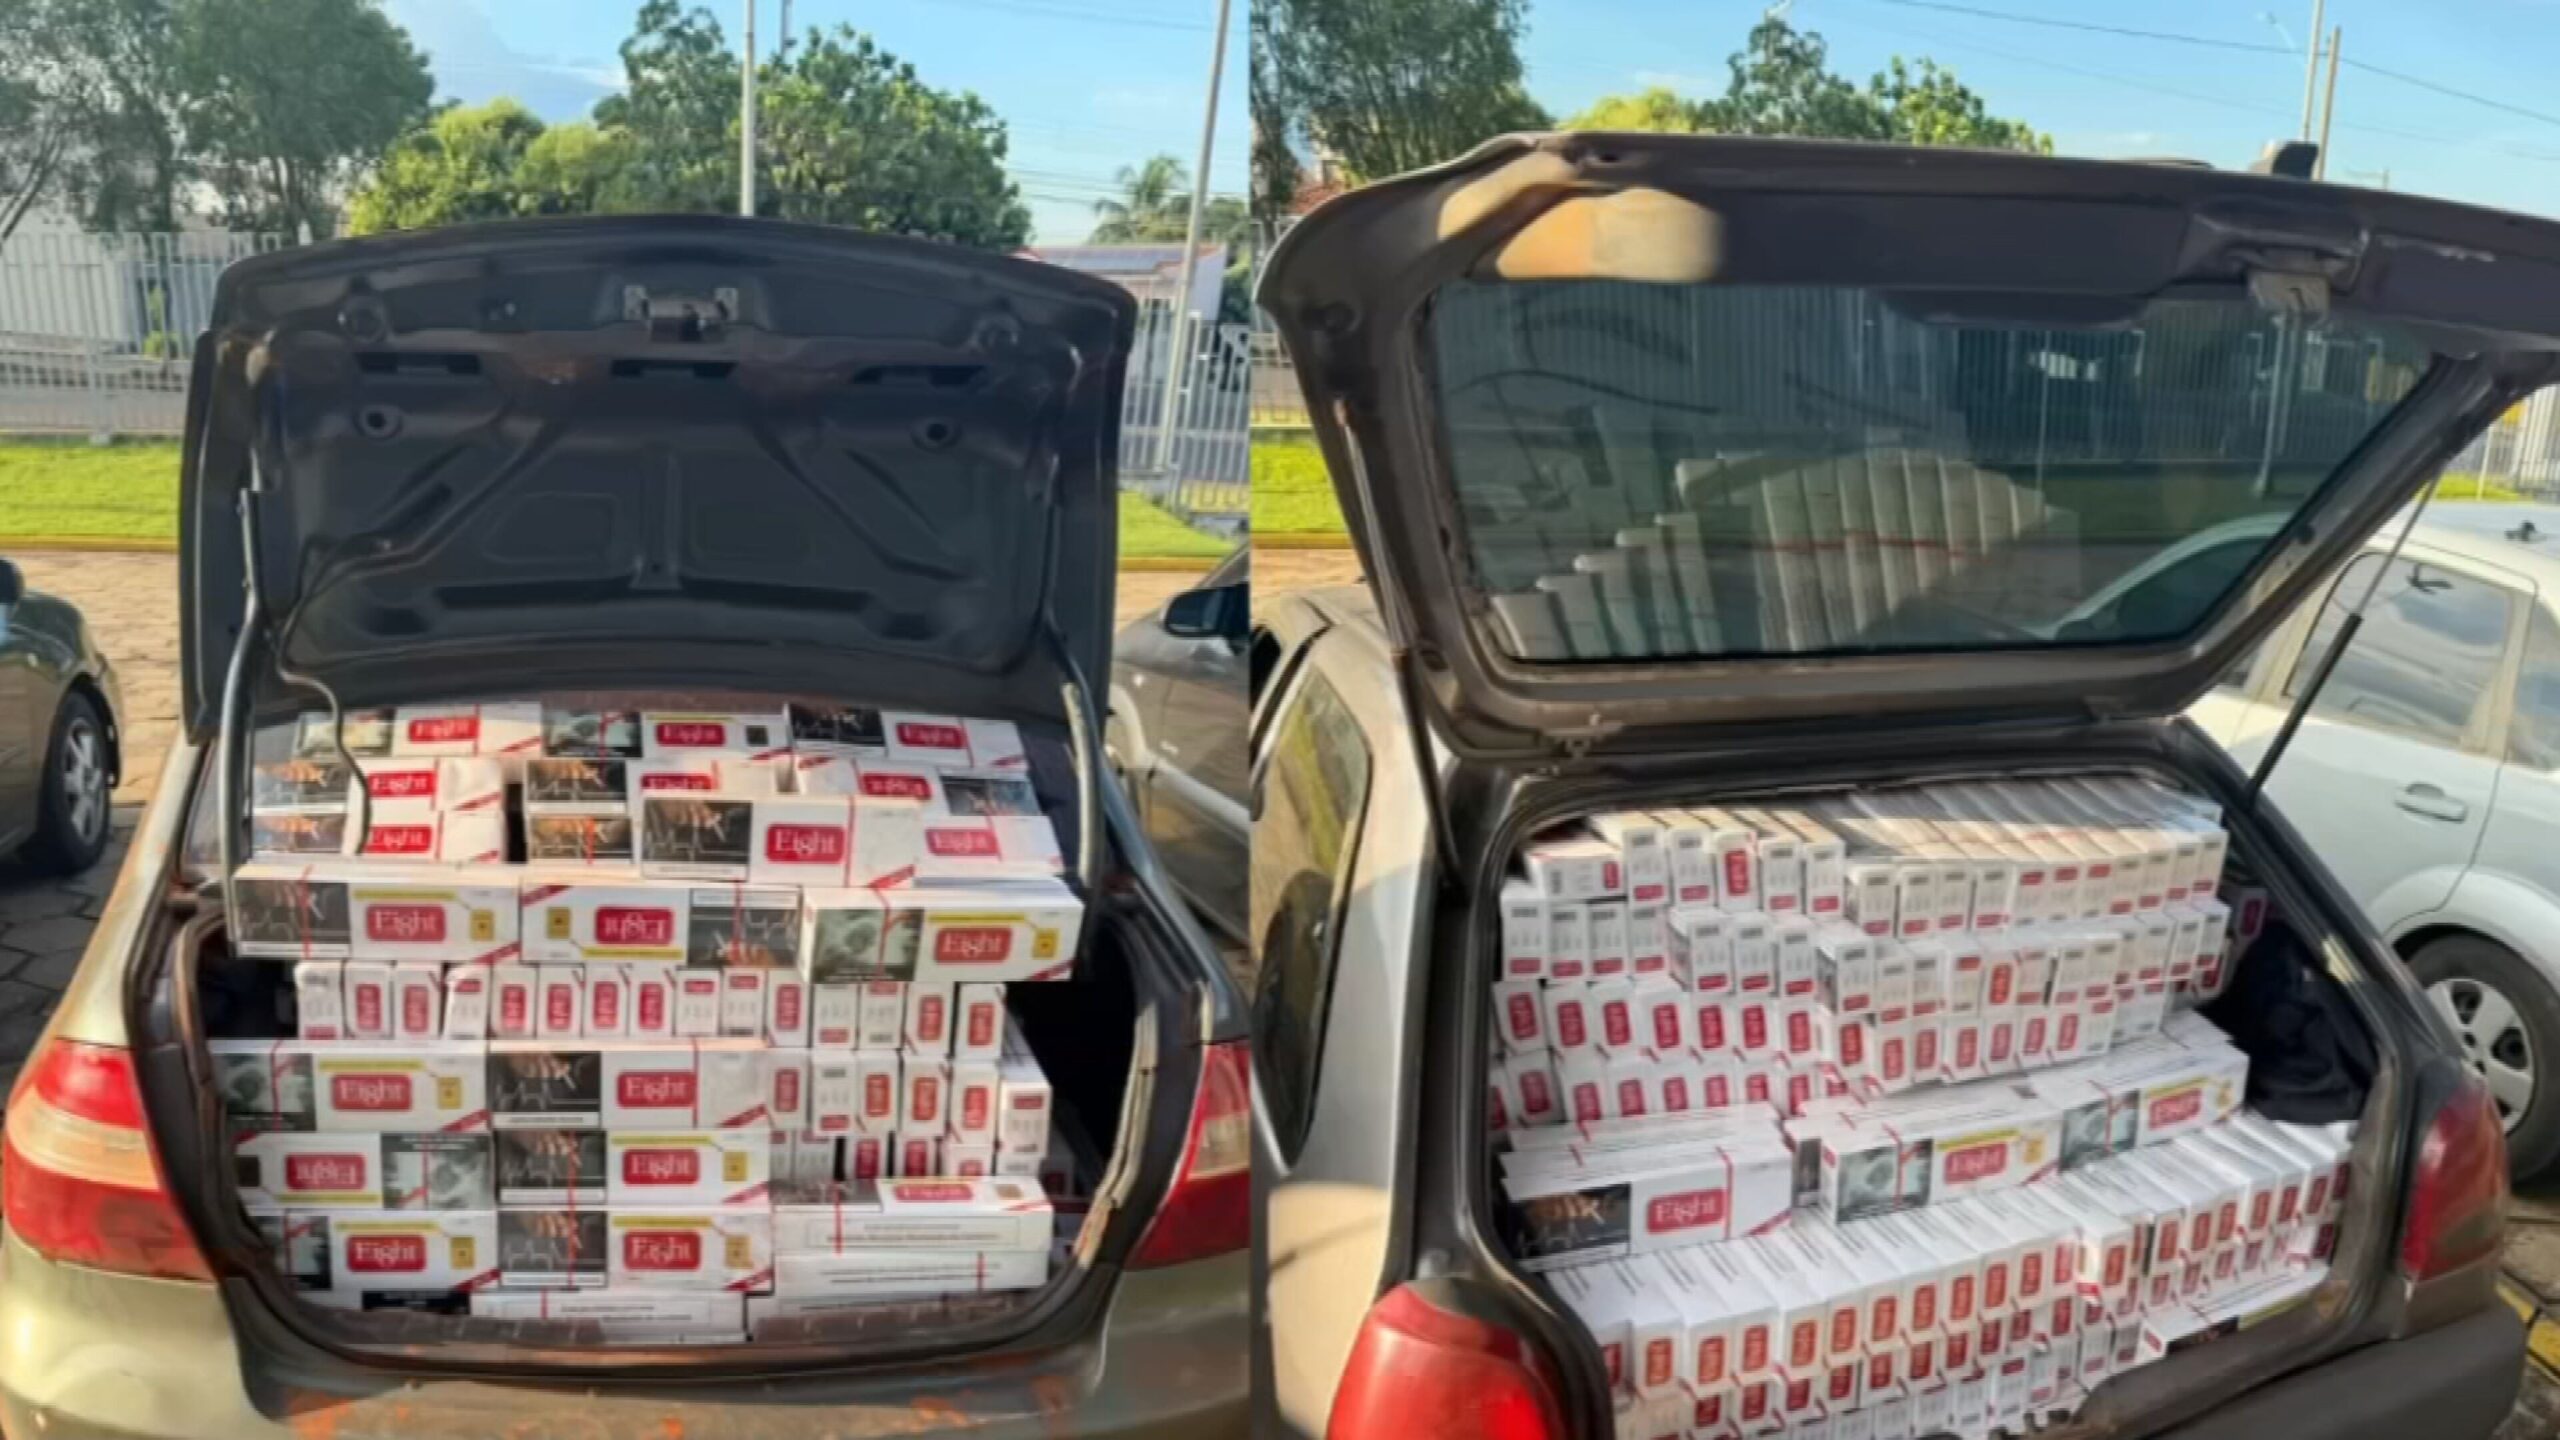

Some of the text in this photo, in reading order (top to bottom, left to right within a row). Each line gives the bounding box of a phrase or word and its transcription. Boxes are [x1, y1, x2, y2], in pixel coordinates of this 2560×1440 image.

[373, 774, 430, 796] Eight
[775, 828, 838, 858] Eight
[374, 909, 438, 938] Eight
[605, 910, 667, 940] Eight
[946, 930, 1004, 959] Eight
[339, 1078, 404, 1108] Eight
[626, 1075, 690, 1103] Eight
[297, 1156, 358, 1186] Eight
[631, 1154, 692, 1181] Eight
[1655, 1194, 1719, 1228] Eight
[356, 1239, 417, 1267] Eight
[631, 1236, 691, 1265] Eight
